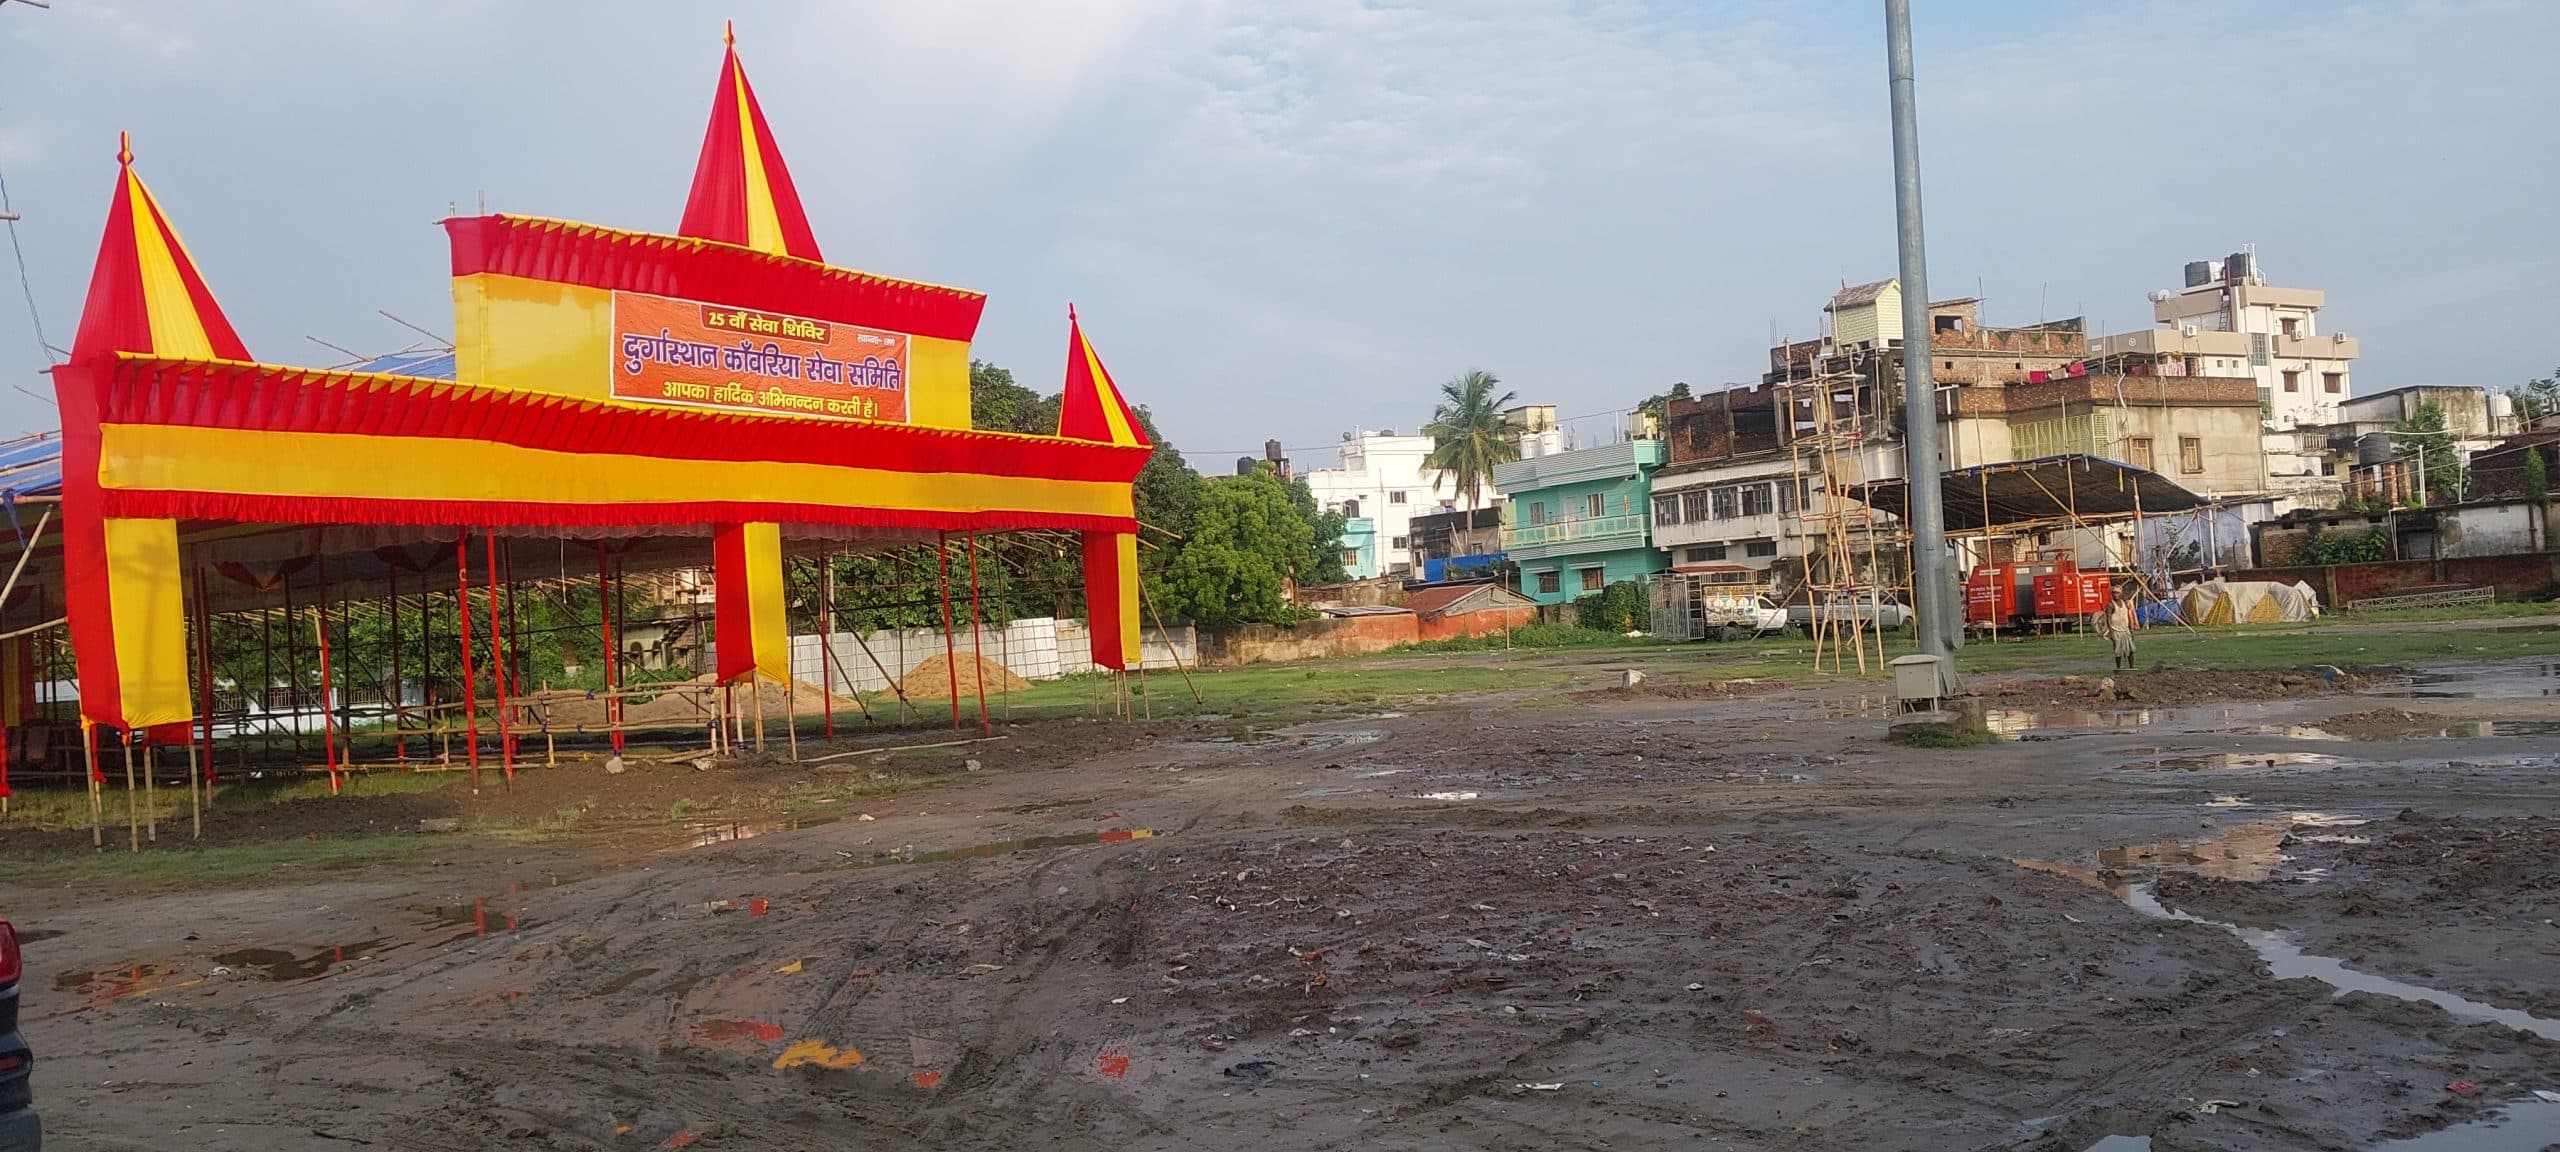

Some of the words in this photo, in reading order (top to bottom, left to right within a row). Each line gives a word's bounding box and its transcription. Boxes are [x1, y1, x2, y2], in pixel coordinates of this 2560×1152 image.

[708, 312, 725, 326] 25
[728, 311, 747, 329] वाँ
[748, 314, 779, 333] सेवा
[782, 318, 825, 340] शिविर
[622, 328, 719, 375] दुर्गास्थान
[722, 340, 801, 379] काँवरिया
[804, 349, 843, 384] सेवा
[846, 356, 901, 391] समिति
[662, 381, 710, 400] आपका
[713, 382, 754, 403] हार्दिक
[758, 387, 824, 410] अभिनन्दन
[827, 395, 860, 415] करती
